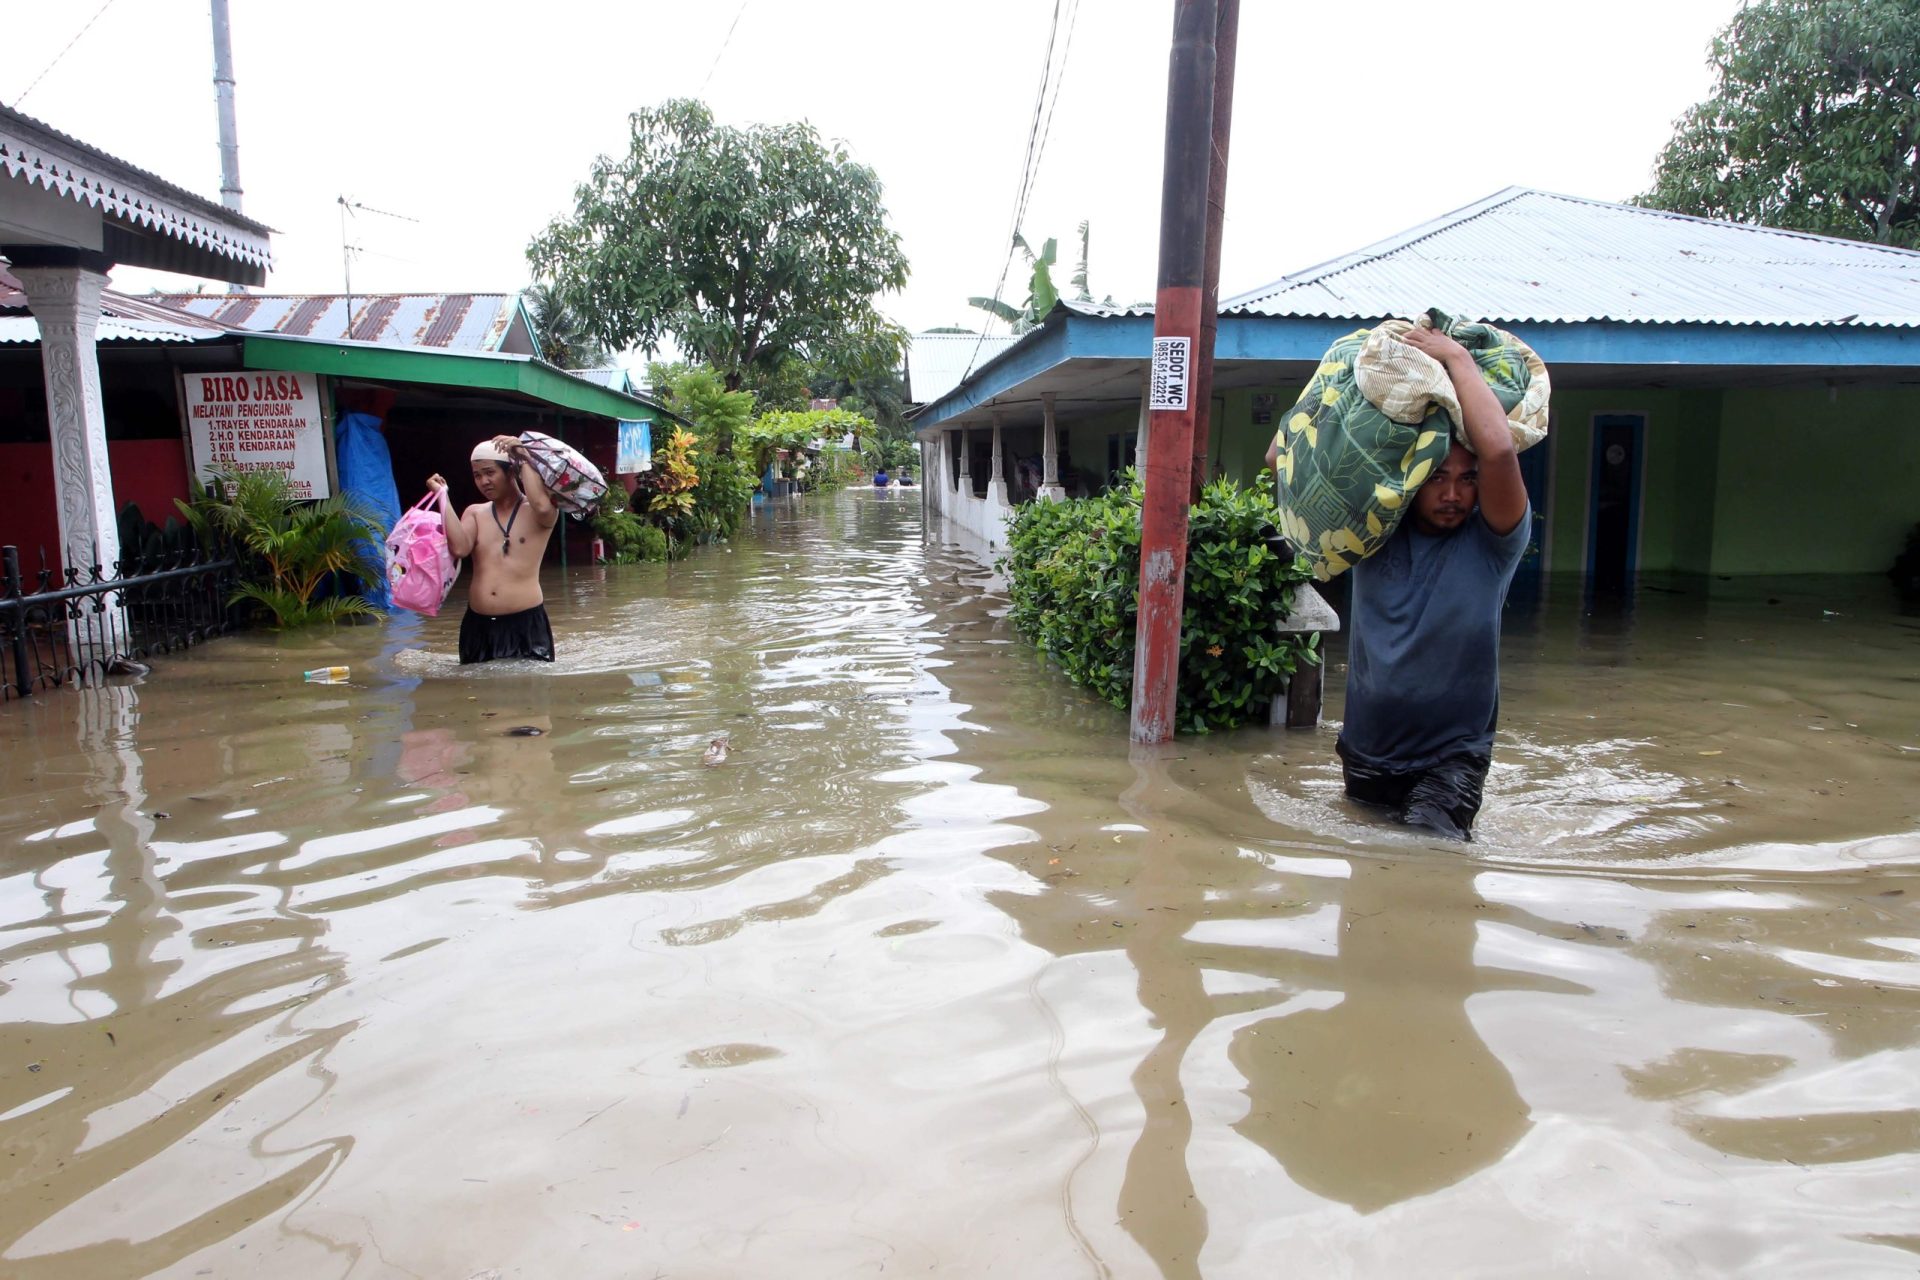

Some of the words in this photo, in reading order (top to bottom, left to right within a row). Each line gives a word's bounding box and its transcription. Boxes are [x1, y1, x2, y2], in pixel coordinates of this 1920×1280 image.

[1169, 342, 1185, 380] SEDOT
[201, 376, 250, 402] BIRO
[253, 375, 303, 400] JASA
[1167, 384, 1183, 405] WC
[193, 405, 233, 418] MELAYANI
[237, 403, 293, 417] PENGURUSAN:
[253, 418, 306, 428] KENDARAAN
[238, 429, 295, 440] KENDARAAN
[219, 441, 236, 452] KIR
[239, 440, 295, 451] KENDARAAN
